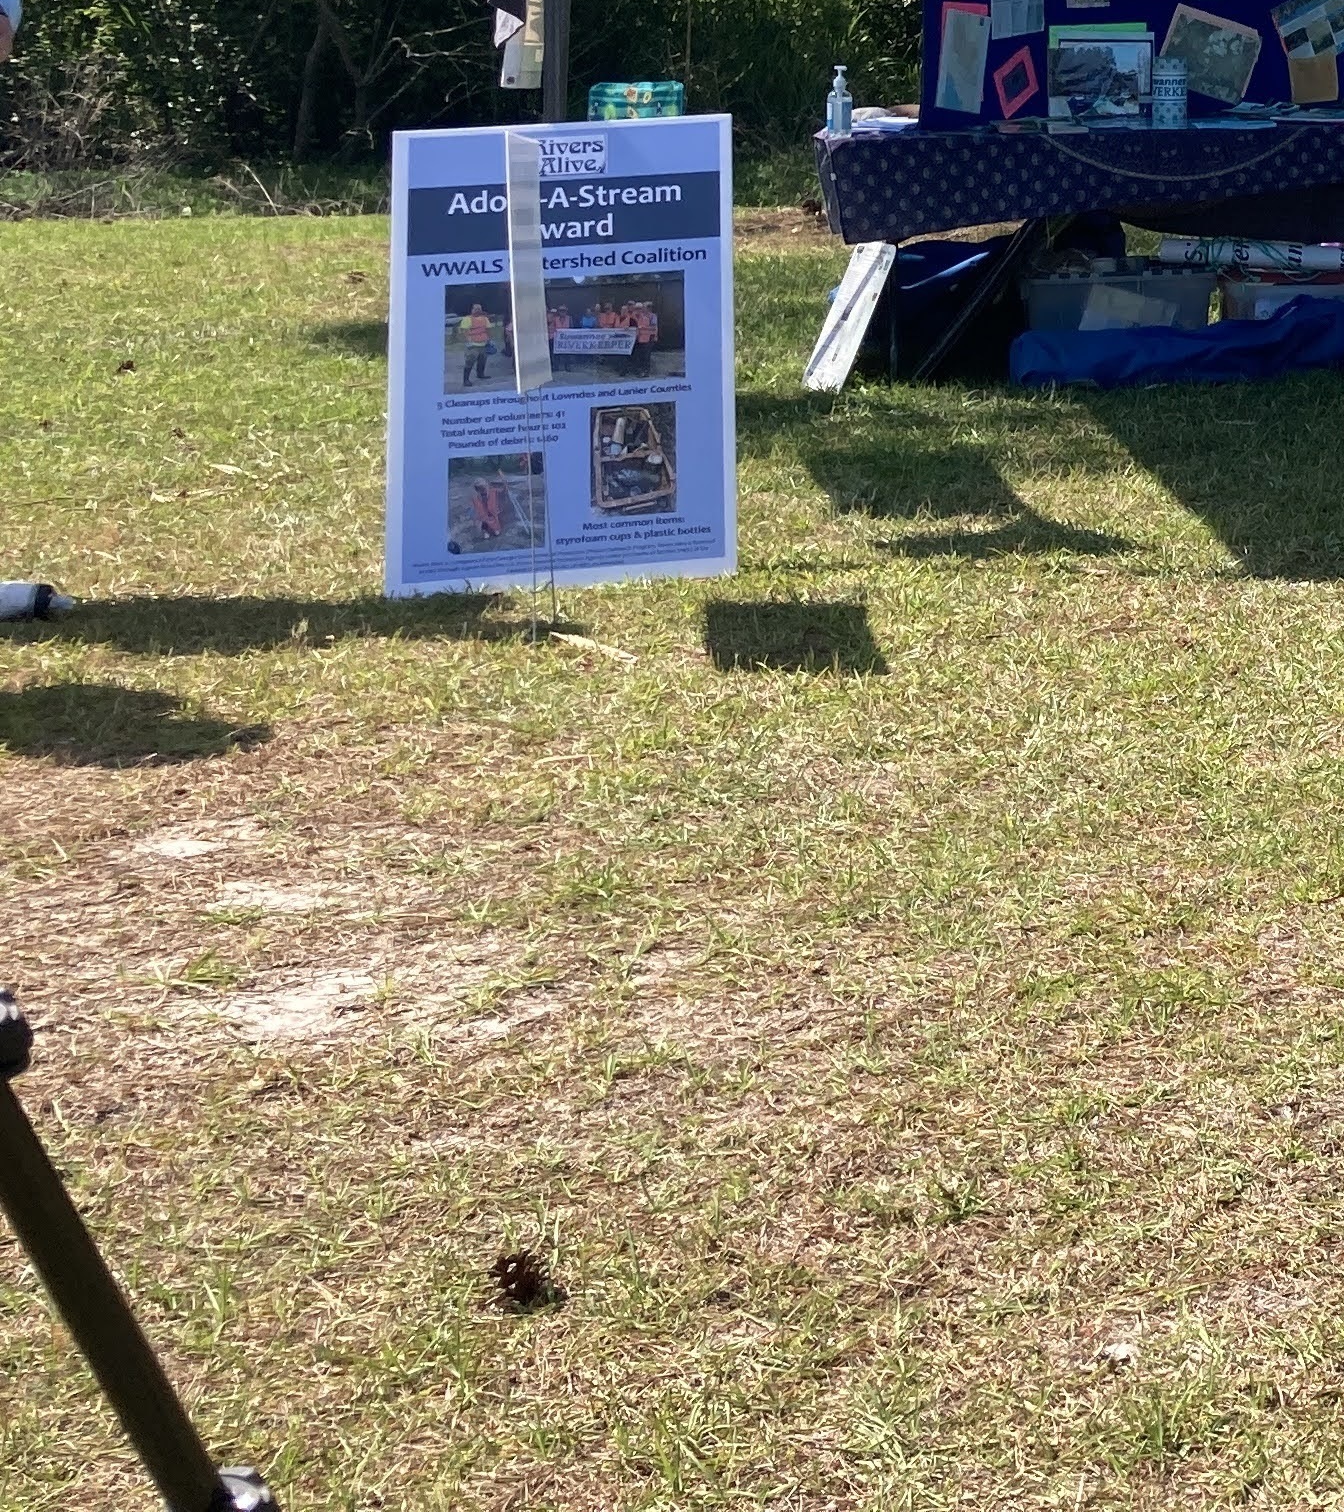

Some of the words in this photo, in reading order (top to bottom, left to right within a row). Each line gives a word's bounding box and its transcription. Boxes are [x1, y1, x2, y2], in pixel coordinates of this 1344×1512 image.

[448, 184, 682, 215] Ado-A-Stream
[540, 213, 614, 239] ward
[421, 259, 504, 278] WWALS
[530, 250, 616, 271] tershed
[621, 246, 707, 265] Coalition
[445, 399, 491, 408] Cleanups
[552, 391, 596, 400] Lowndes
[598, 389, 616, 397] and
[618, 387, 648, 395] Lanier
[442, 416, 483, 425] Number
[485, 414, 496, 423] of
[441, 428, 466, 438] Total
[467, 425, 515, 435] volunteer
[448, 439, 486, 449] Pounds
[488, 437, 499, 446] of
[582, 521, 607, 531] Most
[610, 519, 653, 528] common
[556, 534, 607, 546] styrofoam
[609, 531, 632, 542] cups
[634, 530, 642, 539] &
[644, 528, 676, 540] plastic
